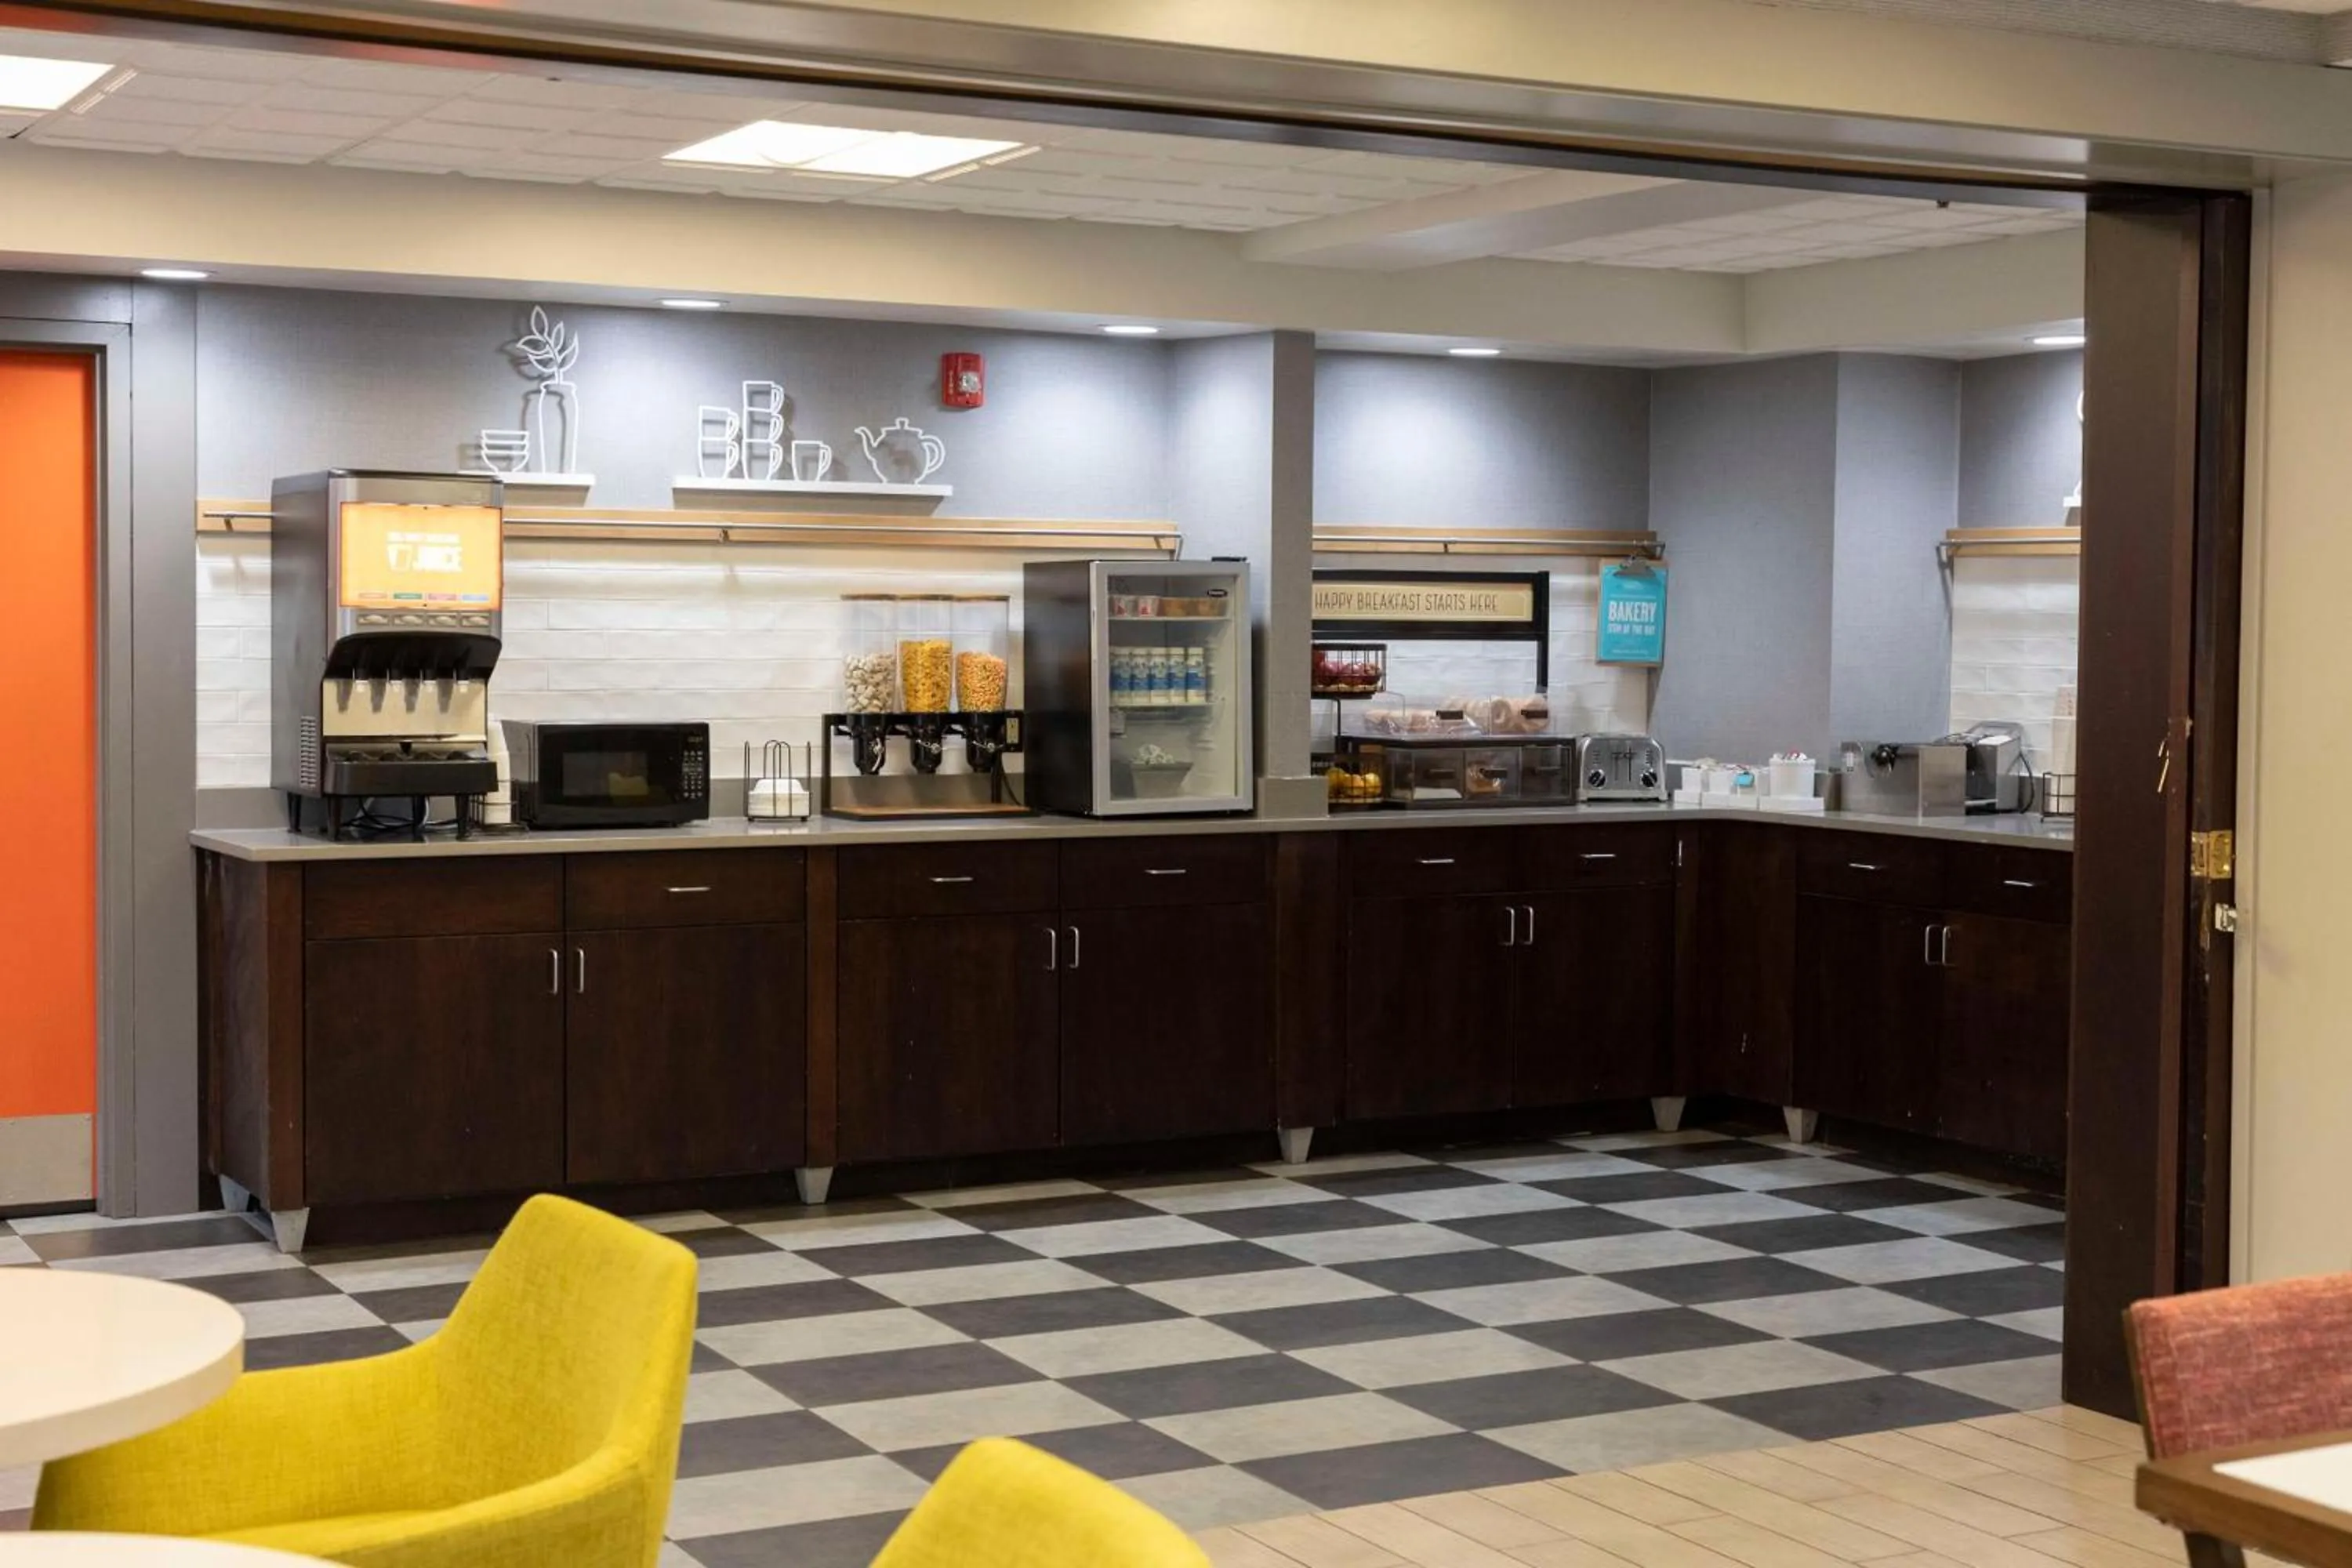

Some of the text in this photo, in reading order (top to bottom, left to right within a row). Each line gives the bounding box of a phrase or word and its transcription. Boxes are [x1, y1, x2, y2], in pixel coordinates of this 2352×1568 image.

[1315, 592, 1498, 612] HAPPY BREAKFAST STARTS HERE
[1608, 601, 1657, 622] BAKERY
